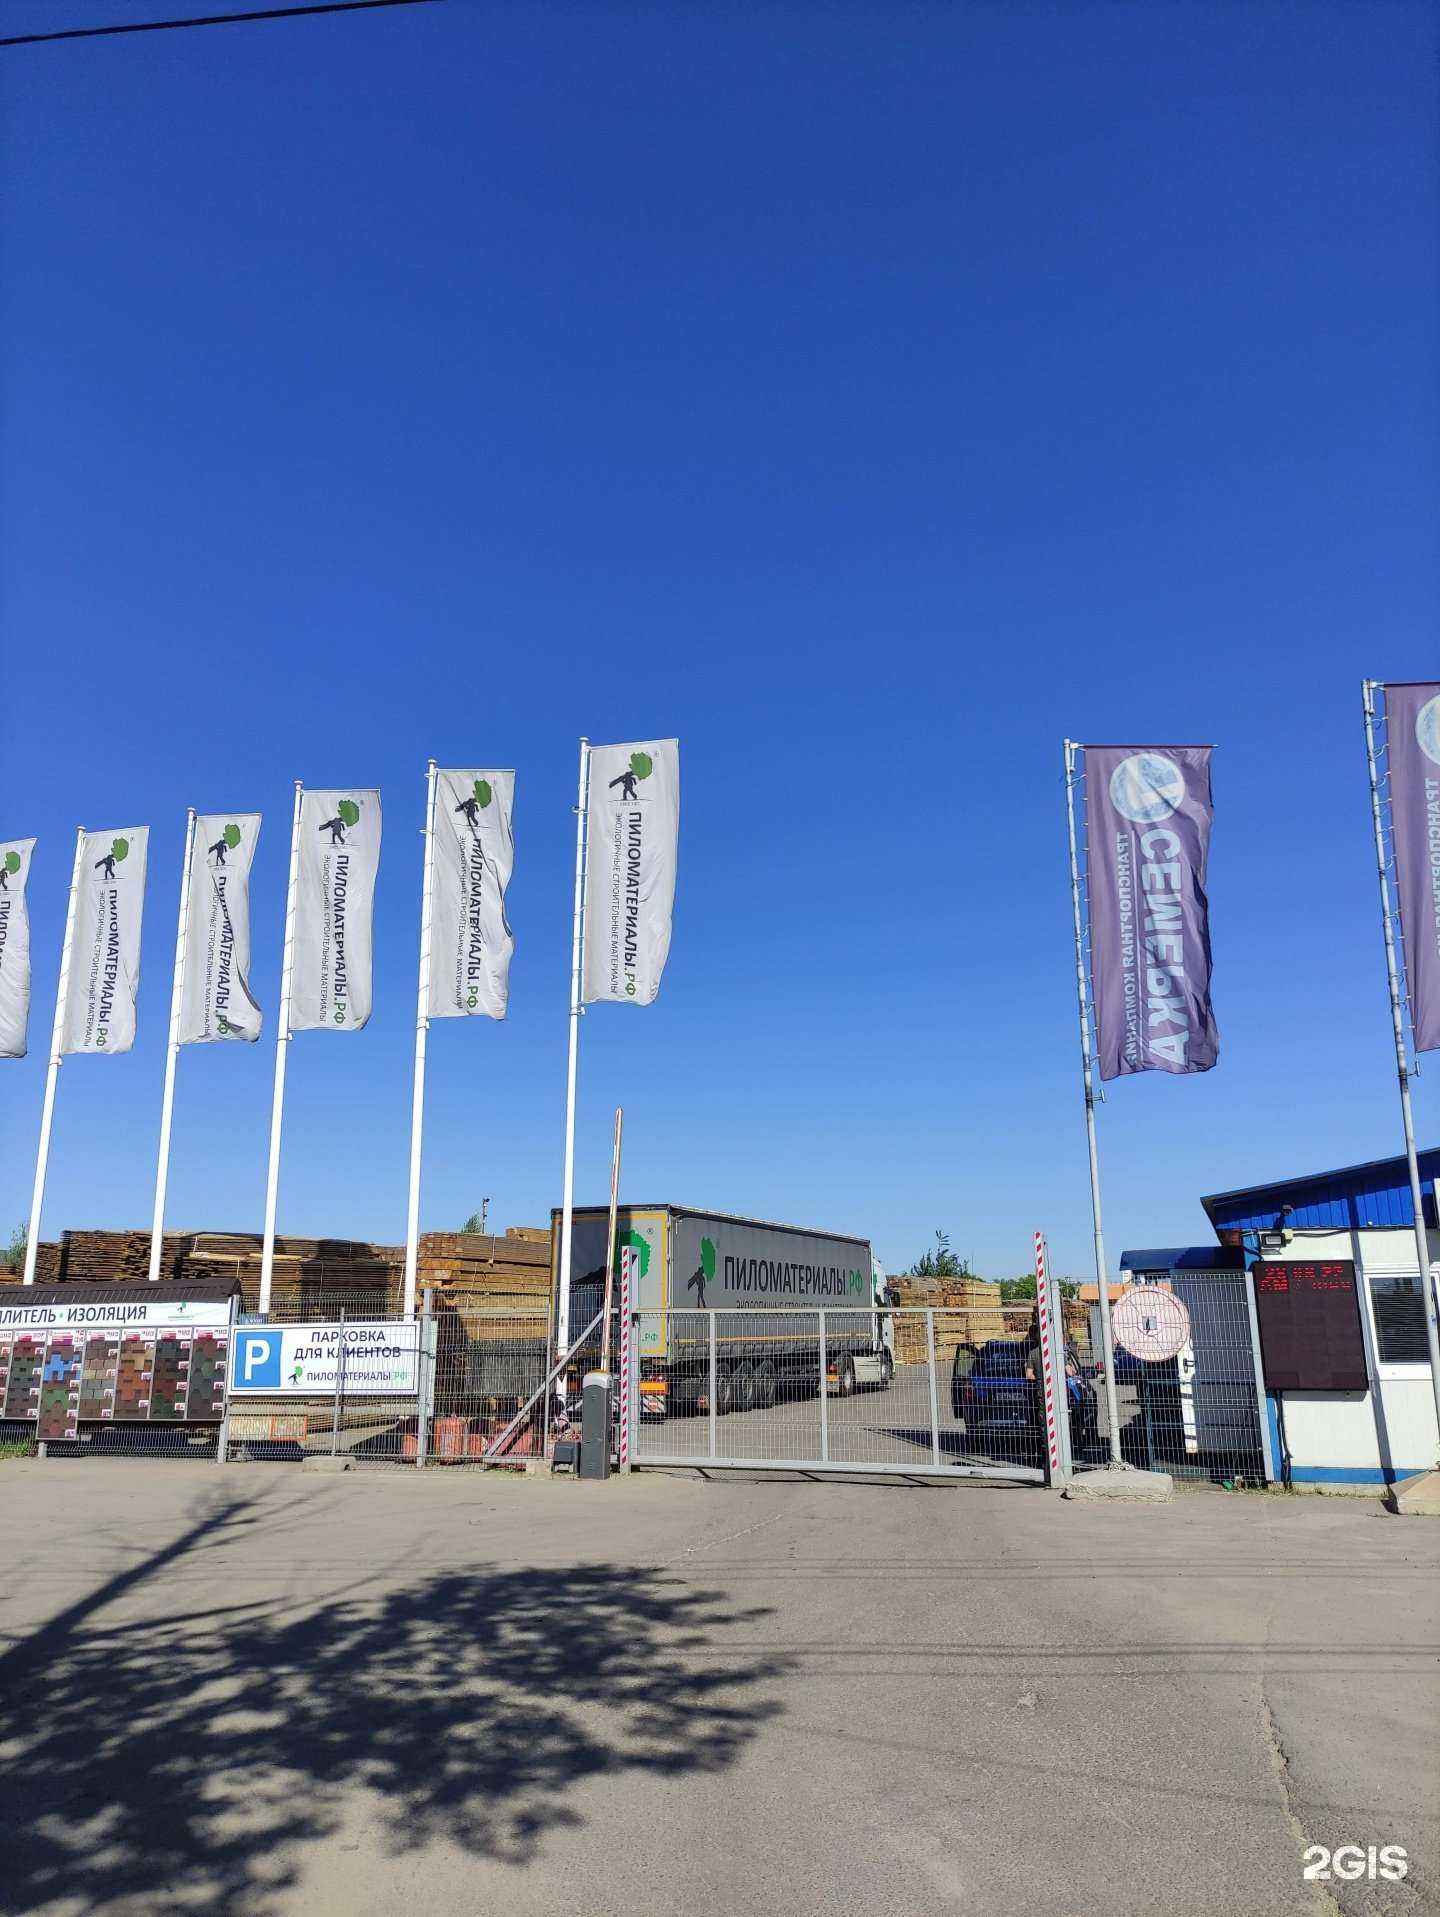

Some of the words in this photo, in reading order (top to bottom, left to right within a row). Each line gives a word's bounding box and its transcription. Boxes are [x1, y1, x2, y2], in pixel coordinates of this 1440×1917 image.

[624, 812, 642, 996] ПИЛОМАТЕРИАЛЫ.РФ
[332, 854, 350, 1025] ПИЛОМАТЕРИАЛЫ.РФ
[609, 940, 619, 994] МАТЕРИАЛЫ
[0, 1310, 56, 1323] ЛИТЕЛЬ
[67, 1305, 147, 1323] ИЗОЛЯЦИЯ
[293, 1347, 322, 1361] ДЛЯ
[311, 1330, 386, 1343] ПАРКОВКА
[243, 1339, 271, 1381] P
